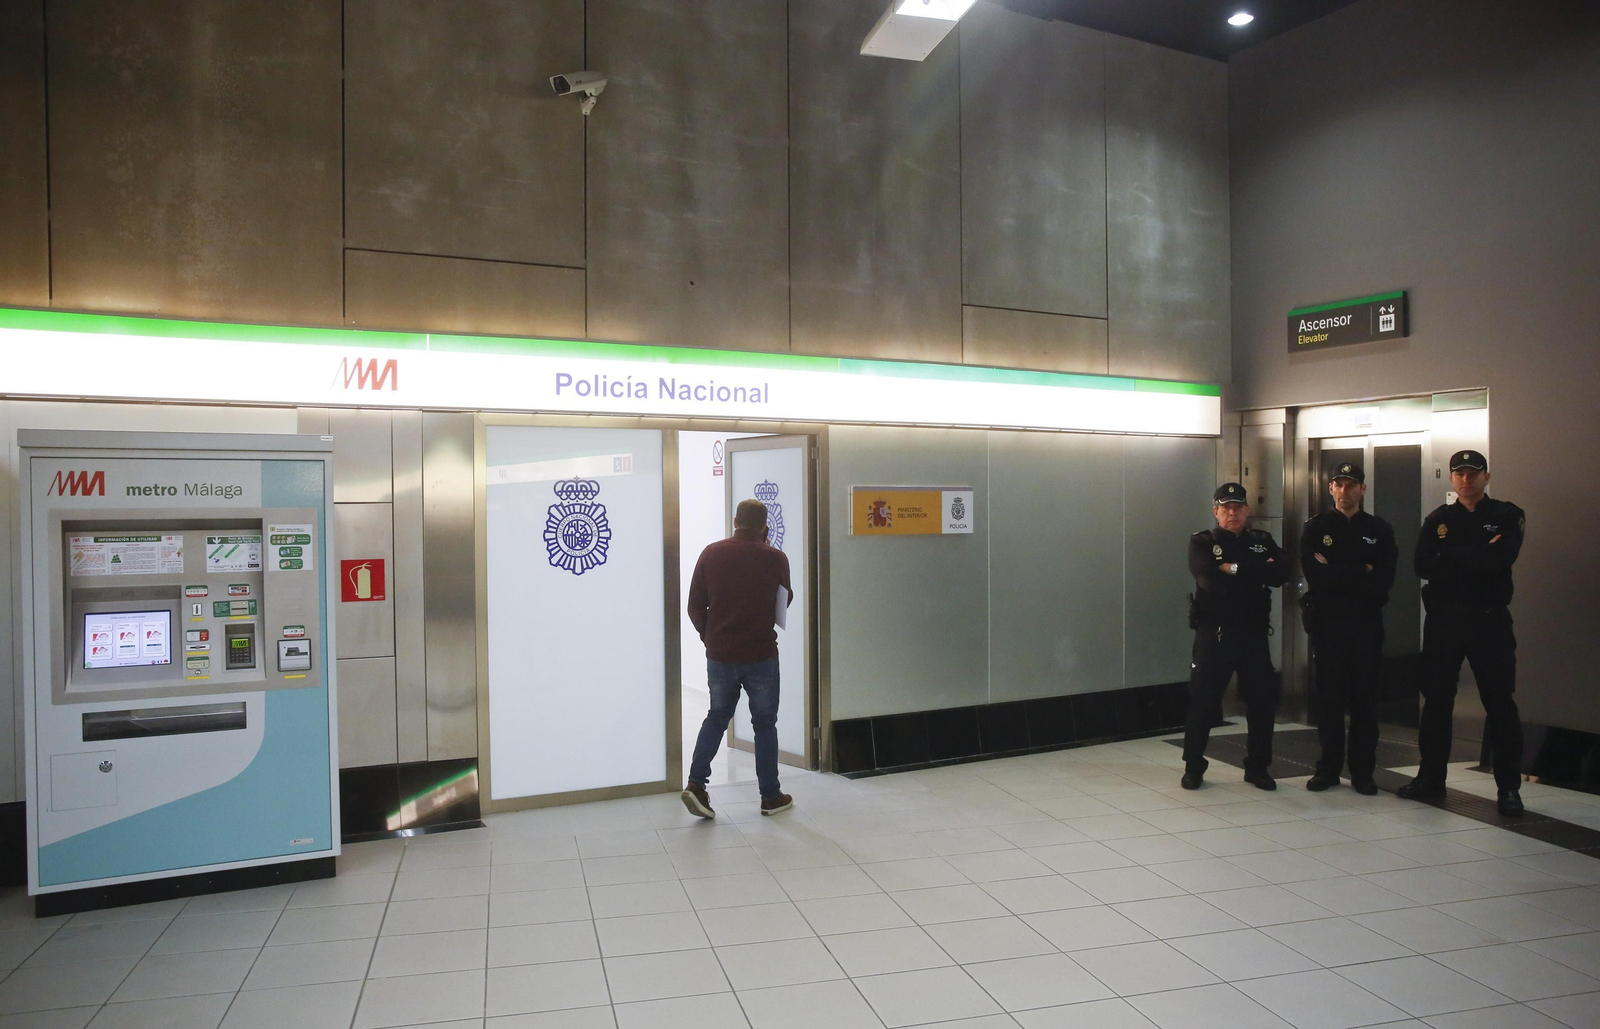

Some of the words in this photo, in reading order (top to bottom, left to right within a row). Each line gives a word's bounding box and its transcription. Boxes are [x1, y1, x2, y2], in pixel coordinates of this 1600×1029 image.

[1298, 314, 1353, 333] Ascensor
[1298, 333, 1329, 345] Elevator
[555, 372, 648, 400] Policía
[658, 377, 769, 404] Nacional
[126, 483, 178, 496] metro
[184, 482, 243, 499] Málaga
